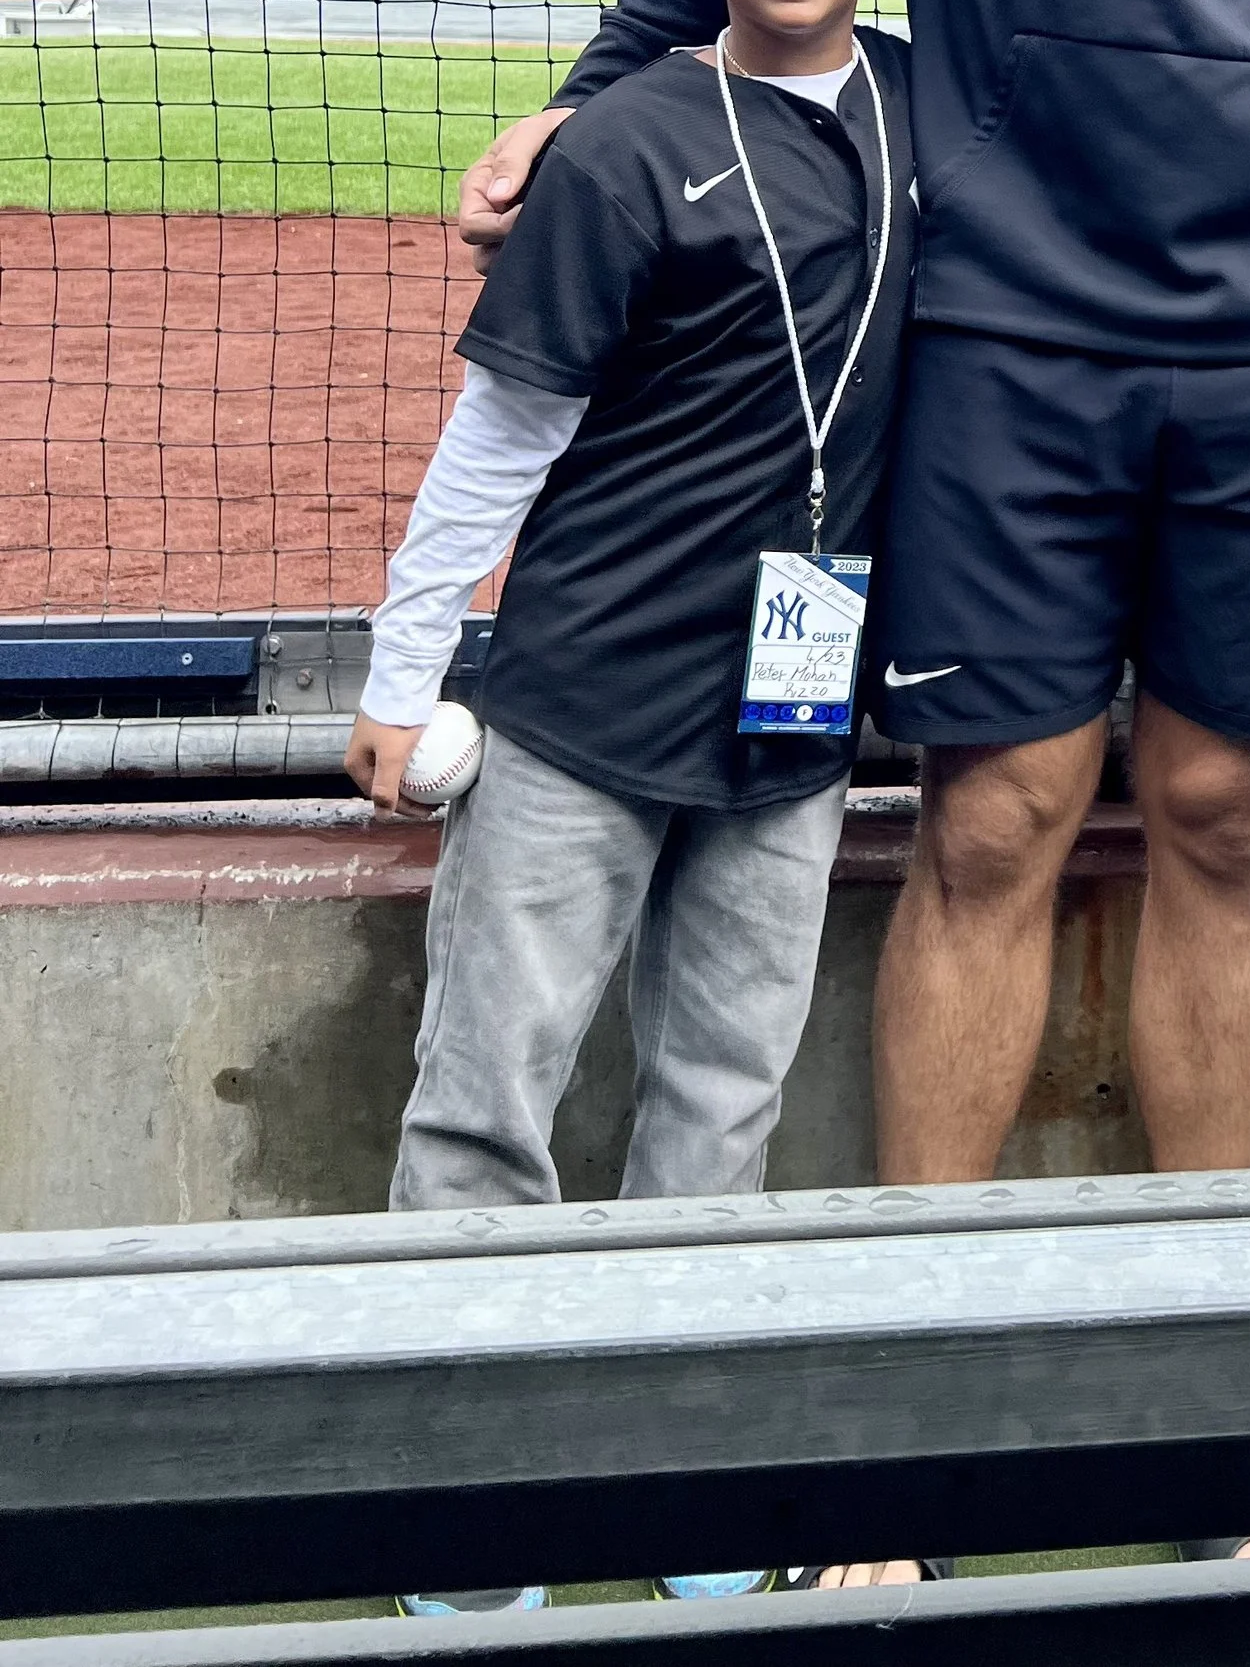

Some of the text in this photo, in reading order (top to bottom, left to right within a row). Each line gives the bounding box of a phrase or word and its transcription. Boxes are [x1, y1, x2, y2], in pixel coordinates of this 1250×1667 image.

[837, 561, 868, 573] 2023
[761, 589, 810, 642] NY
[811, 631, 852, 644] GUEST
[752, 662, 787, 682] Peter
